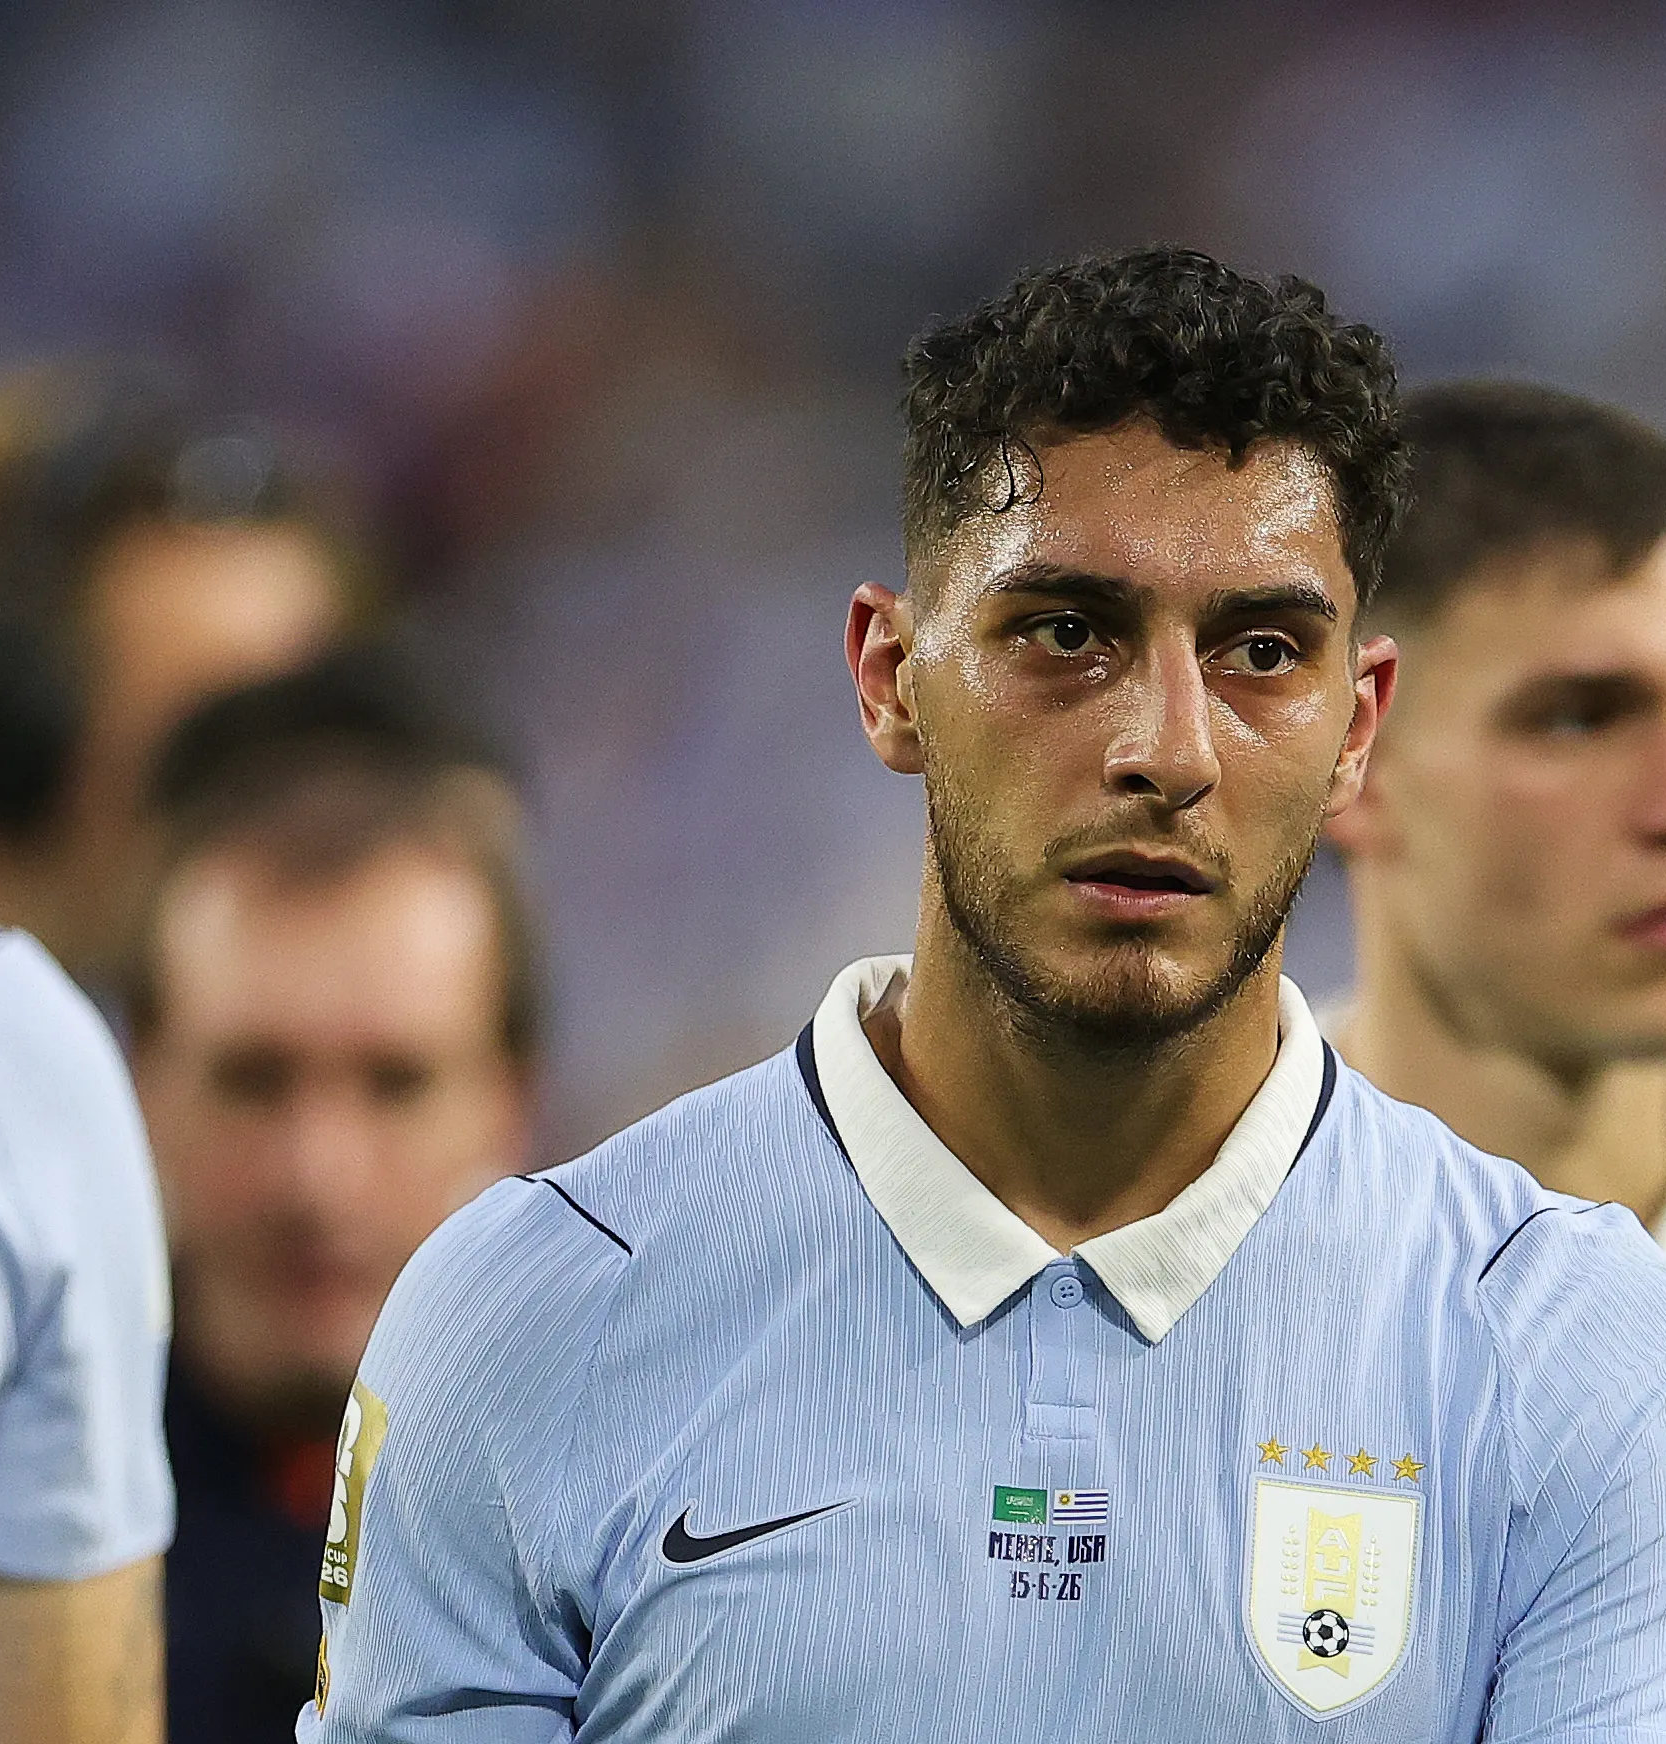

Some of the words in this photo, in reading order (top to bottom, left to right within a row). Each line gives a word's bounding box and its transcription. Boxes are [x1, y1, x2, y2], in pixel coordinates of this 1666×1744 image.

[327, 1547, 348, 1565] CUP
[1067, 1534, 1107, 1563] USA
[321, 1562, 348, 1588] 26
